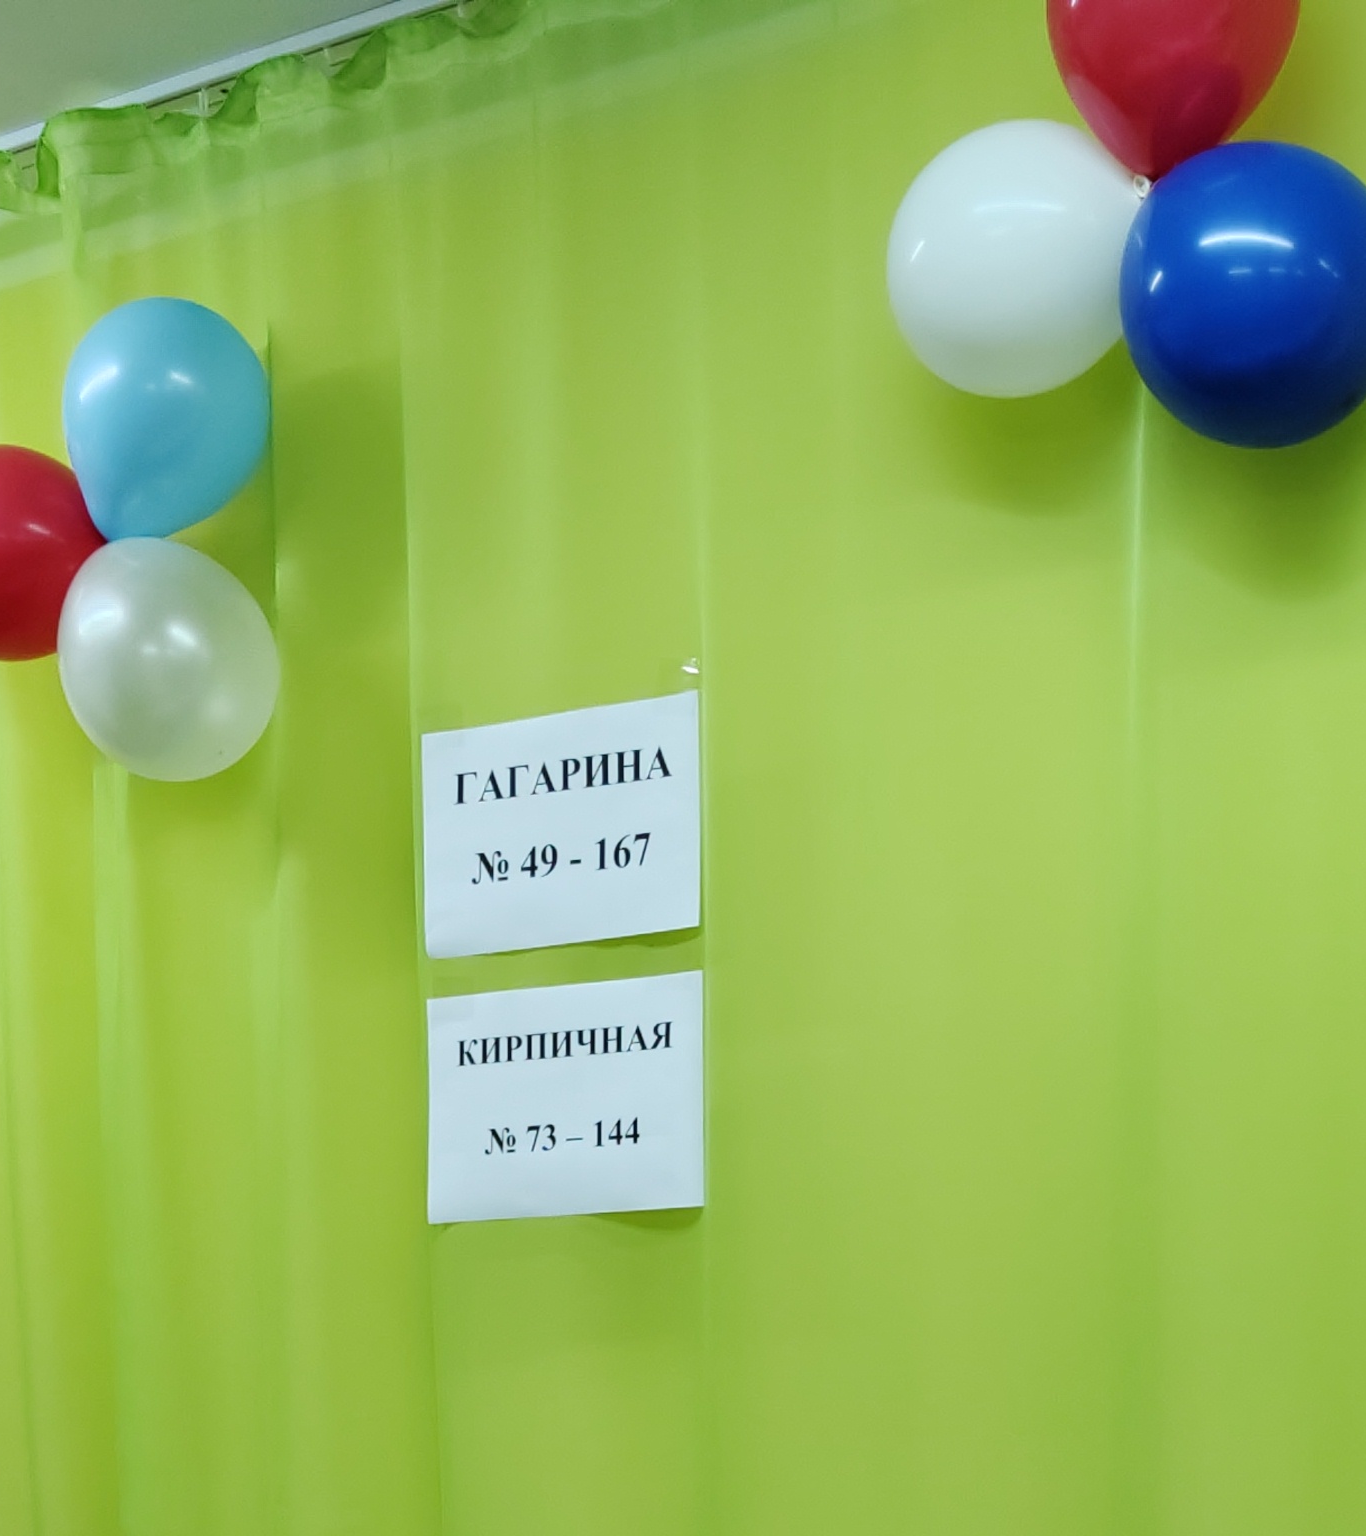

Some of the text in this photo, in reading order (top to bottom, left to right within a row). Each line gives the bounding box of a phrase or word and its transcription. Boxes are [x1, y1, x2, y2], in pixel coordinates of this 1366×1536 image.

[455, 745, 673, 806] ГАГАРИНА
[470, 849, 510, 886] №
[519, 842, 559, 879] 49
[595, 831, 652, 872] 167
[457, 1020, 674, 1068] КИРПИЧНАЯ
[483, 1126, 518, 1157] №
[525, 1122, 558, 1153] 73
[592, 1115, 642, 1148] 144
